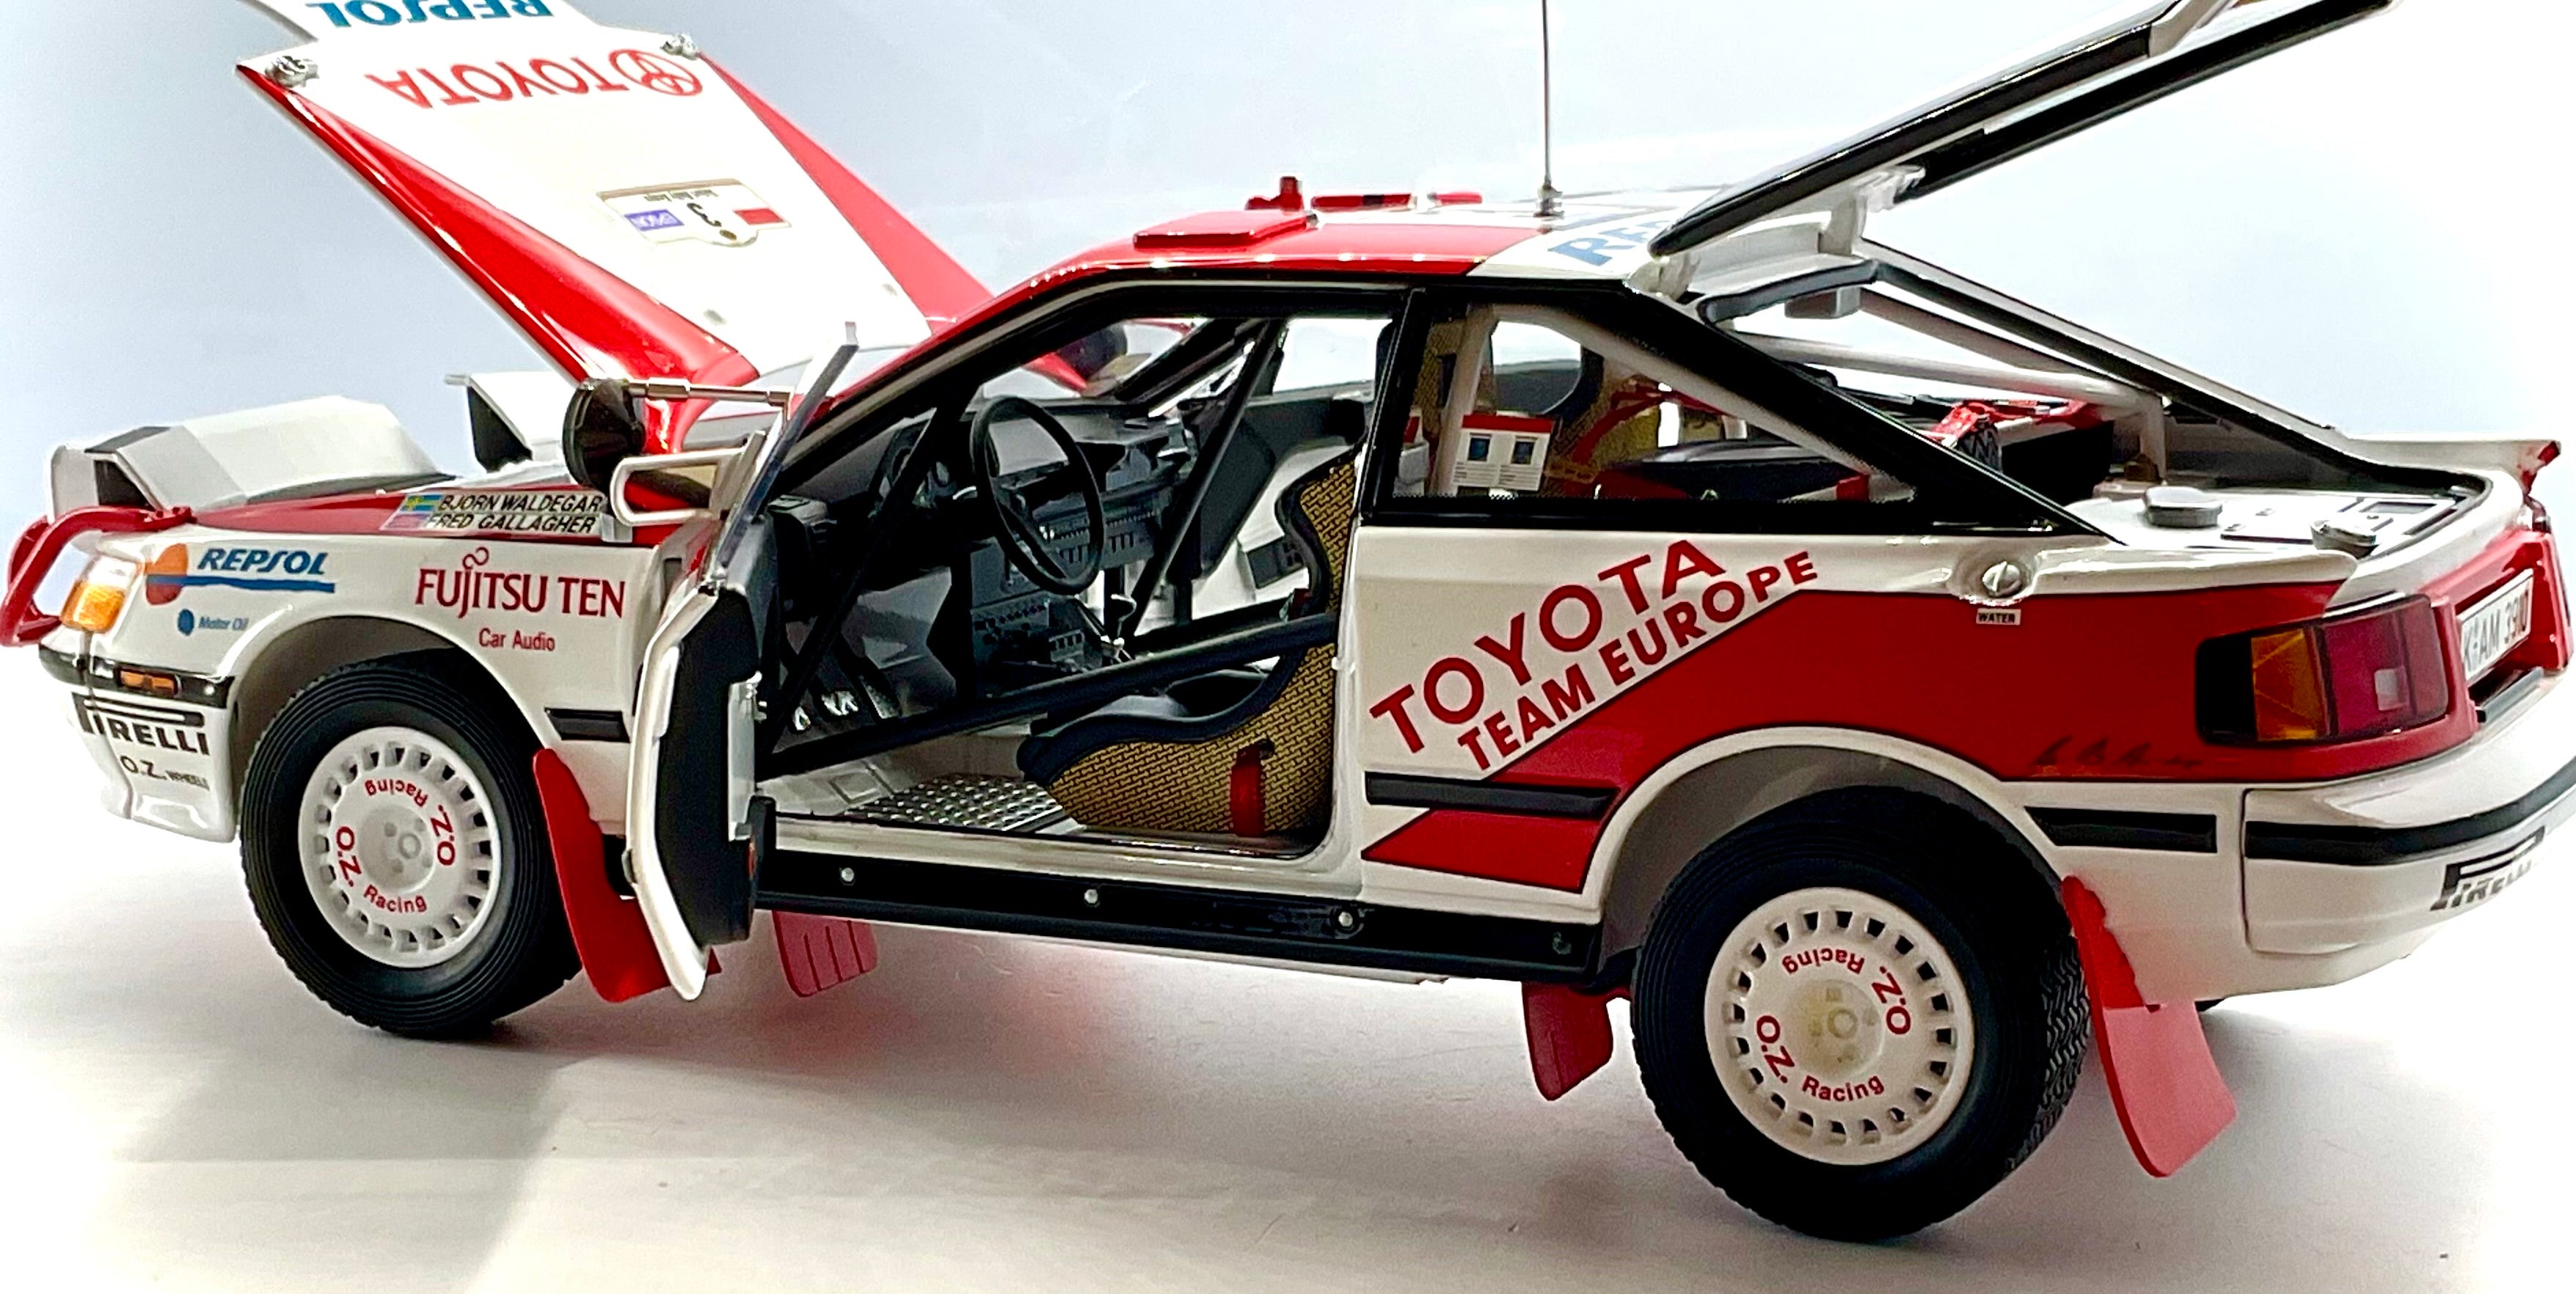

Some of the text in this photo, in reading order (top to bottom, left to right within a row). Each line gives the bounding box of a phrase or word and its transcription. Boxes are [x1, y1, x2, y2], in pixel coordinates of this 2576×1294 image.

[364, 56, 630, 109] TOYOTA
[687, 202, 722, 227] 3
[440, 494, 603, 513] BJORN WALDEGAR
[423, 513, 596, 533] FRED GALLAGHER
[197, 548, 329, 575] REPSOL
[415, 547, 626, 618] FUJITSU TEN
[199, 616, 231, 629] Motor
[1978, 613, 2015, 624] WATER
[479, 628, 555, 651] Car Audio
[1370, 540, 1726, 753] TOYOTA
[1458, 551, 1818, 771] TEAM EUROPE
[71, 691, 210, 756] PIRELLI
[365, 778, 428, 807] Racing
[363, 884, 427, 913] Racing
[1782, 947, 1866, 975] Racing
[1801, 1075, 1885, 1102] Racing
